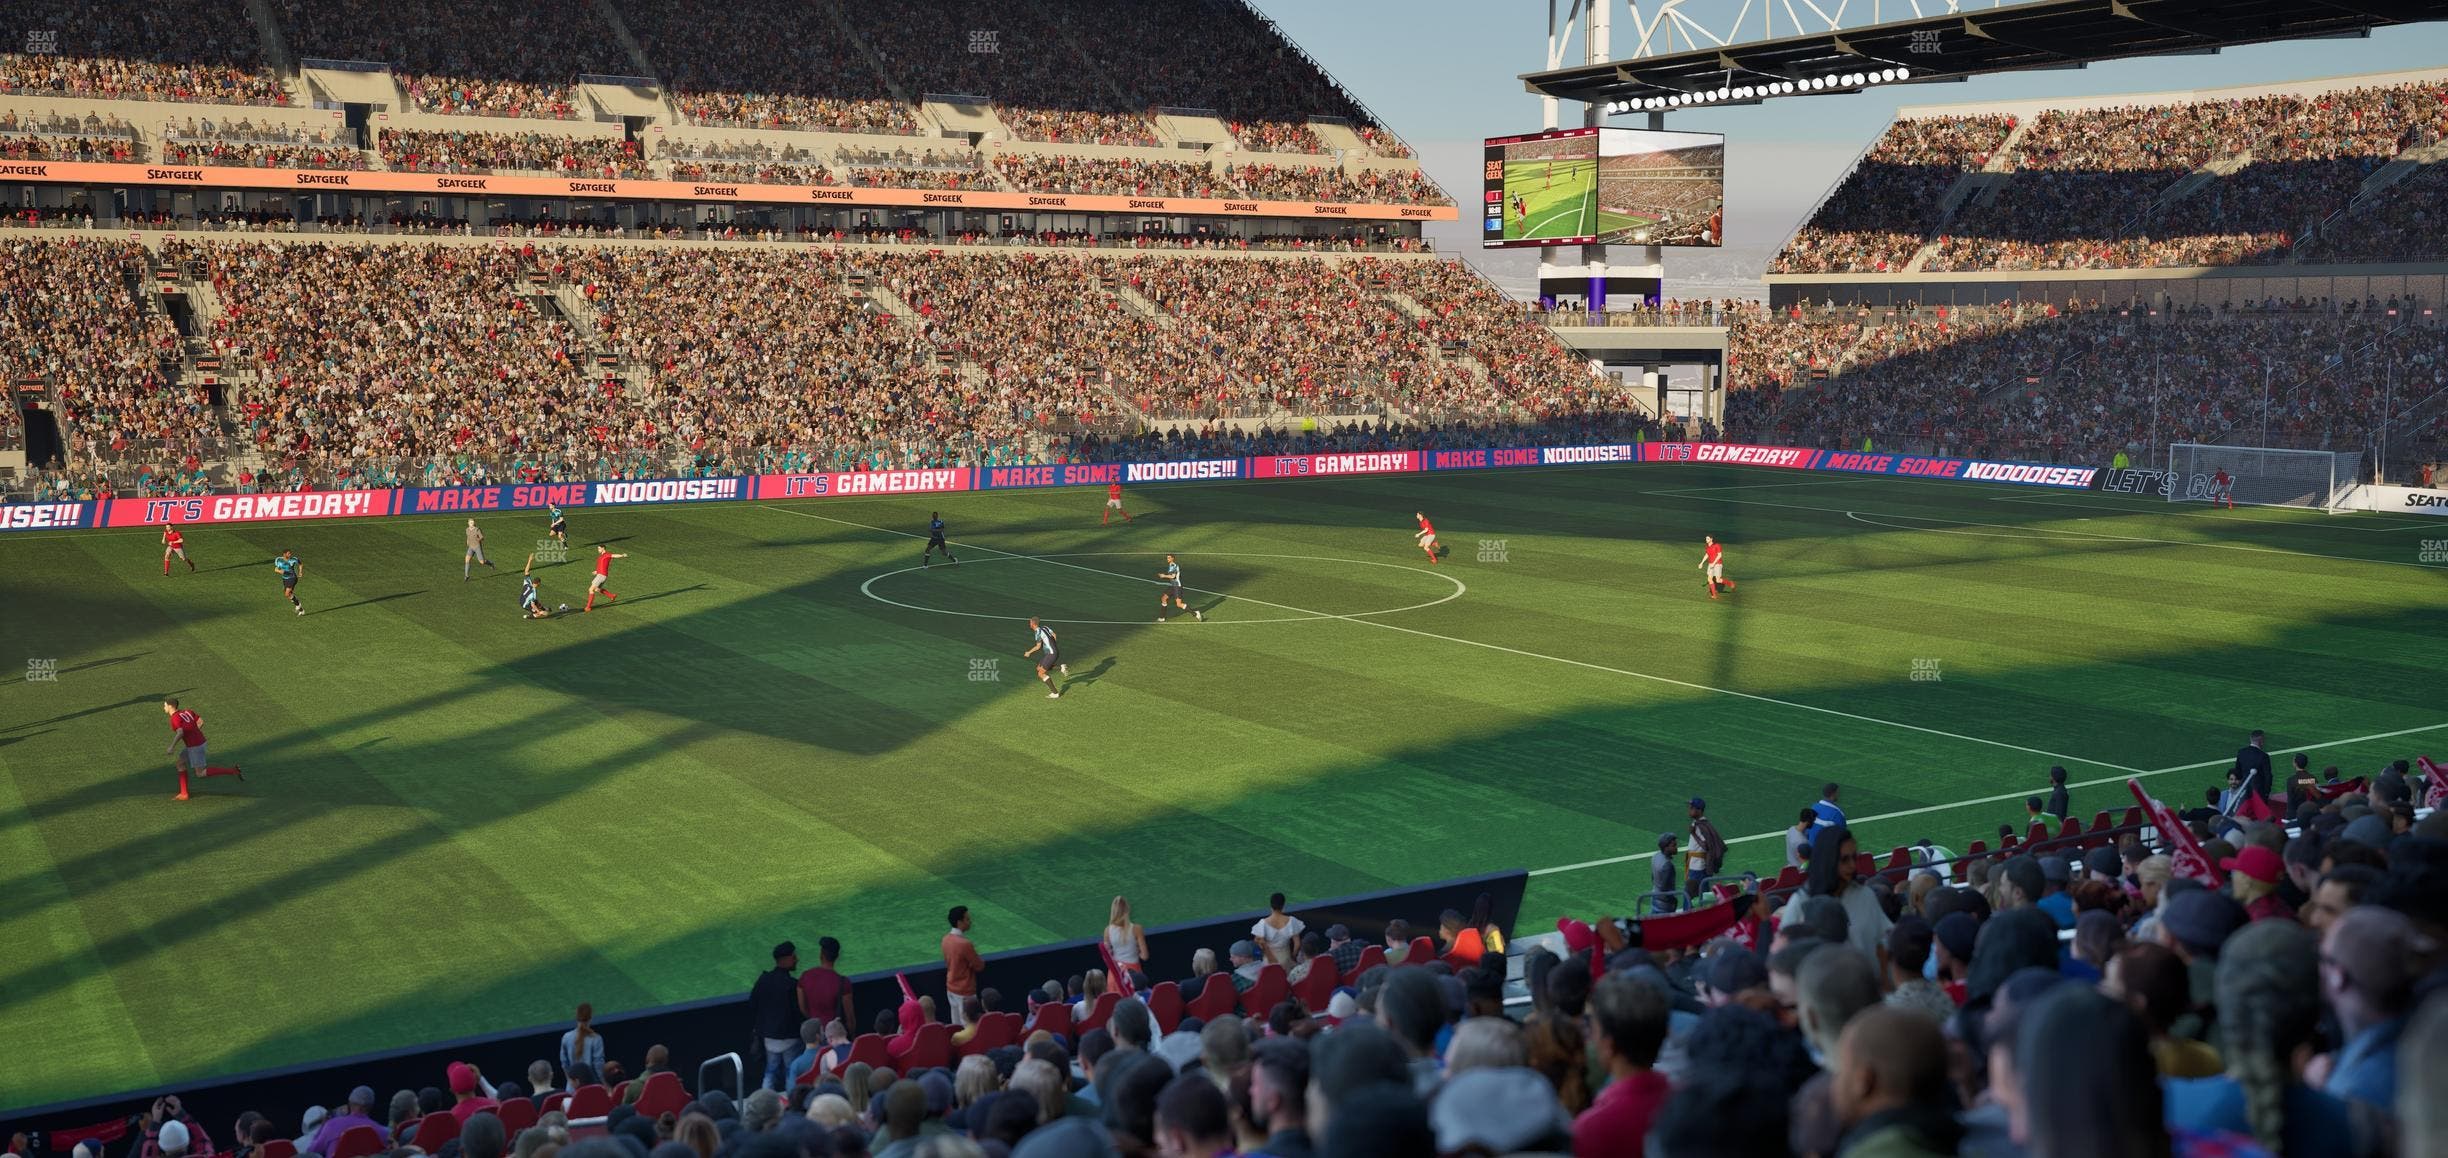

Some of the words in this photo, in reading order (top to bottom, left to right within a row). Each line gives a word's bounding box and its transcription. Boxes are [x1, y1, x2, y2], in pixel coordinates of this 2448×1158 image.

[1487, 161, 1503, 171] SEAT
[148, 169, 203, 181] SEATGEEK
[297, 174, 349, 185] SEATGEEK
[1486, 170, 1503, 180] GEEK
[437, 178, 487, 190] SEATGEEK
[569, 182, 616, 193] SEATGEEK
[694, 186, 738, 197] SEATGEEK
[812, 190, 853, 200] SEATGEEK
[923, 193, 963, 203] SEATGEEK
[1028, 196, 1066, 206] SEATGEEK
[1128, 200, 1164, 209] SEATGEEK
[1224, 203, 1258, 212] SEATGEEK
[1314, 205, 1347, 215] SEATGEEK
[1400, 208, 1432, 217] SEATGEEK
[1436, 450, 1486, 469] MAKE
[1494, 448, 1538, 466] SOME
[1544, 445, 1631, 465] NOOOOISE!!!
[1659, 444, 1692, 461] IT'S
[1697, 444, 1800, 465] GAMEDAY!
[1275, 457, 1308, 475] IT'S
[1315, 453, 1407, 474] GAMEDAY!
[1825, 453, 1893, 472] MAKE
[1896, 458, 1964, 477] SOME
[990, 467, 1055, 487] MAKE
[1064, 464, 1121, 484] SOME
[1127, 460, 1237, 481] NOOOOISE!!!
[785, 475, 828, 495] IT'S
[836, 469, 955, 493] GAMEDAY!
[2102, 468, 2179, 496] LET'S
[416, 487, 499, 512] MAKE
[512, 484, 587, 507] SOME
[594, 478, 738, 504] NOOOOISE!!!
[2405, 493, 2448, 508] SEAT
[145, 499, 203, 523] IT'S
[213, 493, 371, 520] GAMEDAY!
